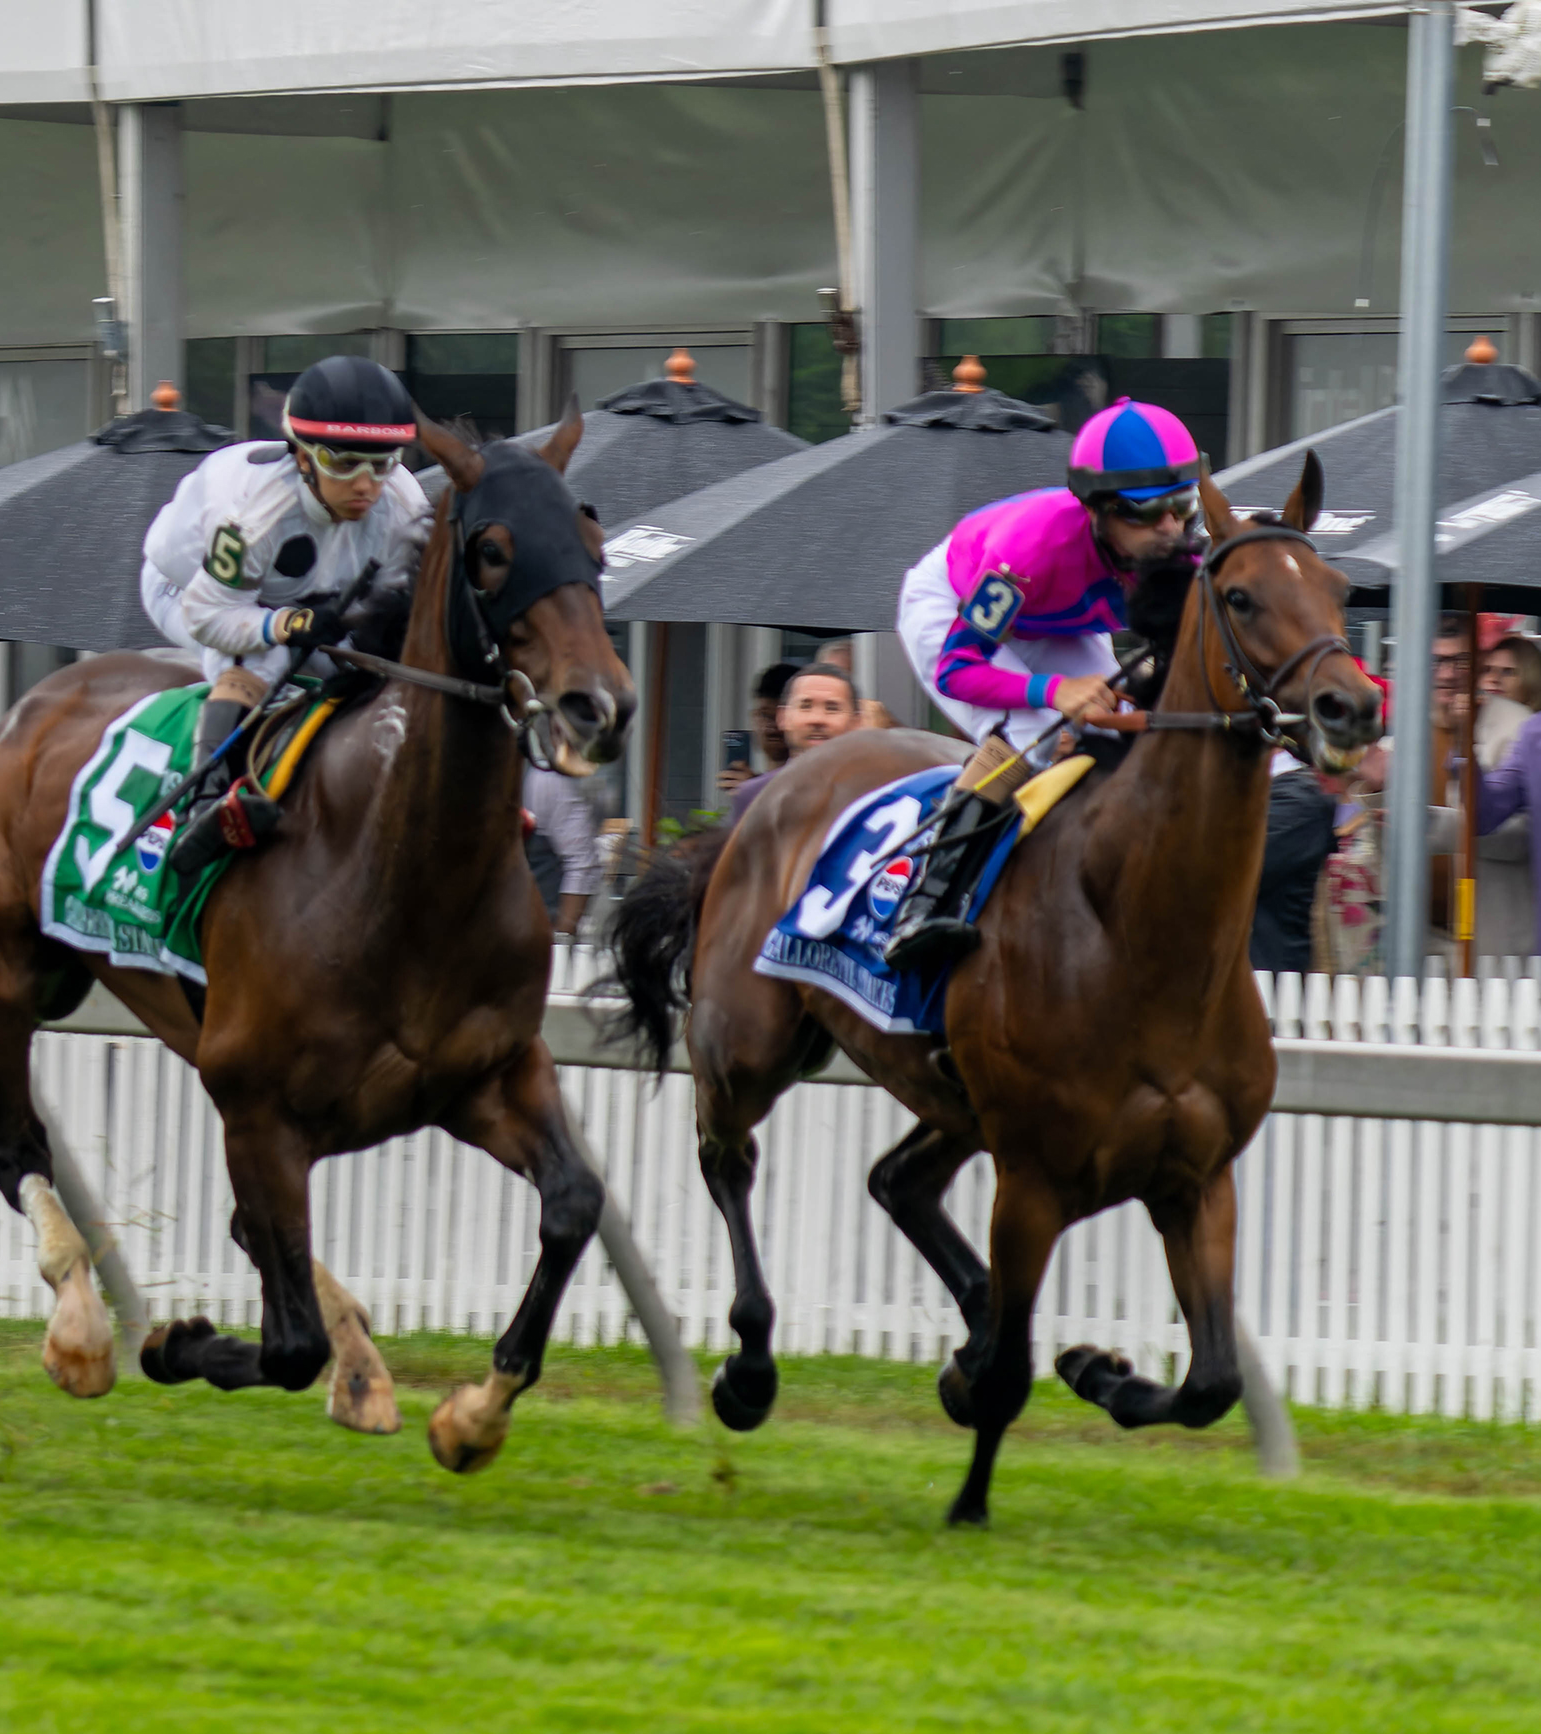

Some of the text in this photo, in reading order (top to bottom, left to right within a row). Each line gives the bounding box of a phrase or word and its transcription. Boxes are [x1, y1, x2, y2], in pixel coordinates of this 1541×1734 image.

[326, 424, 407, 436] BARBOSA
[213, 530, 242, 579] 5
[972, 580, 1014, 631] 3
[74, 727, 174, 896] 5
[797, 795, 923, 941] 3
